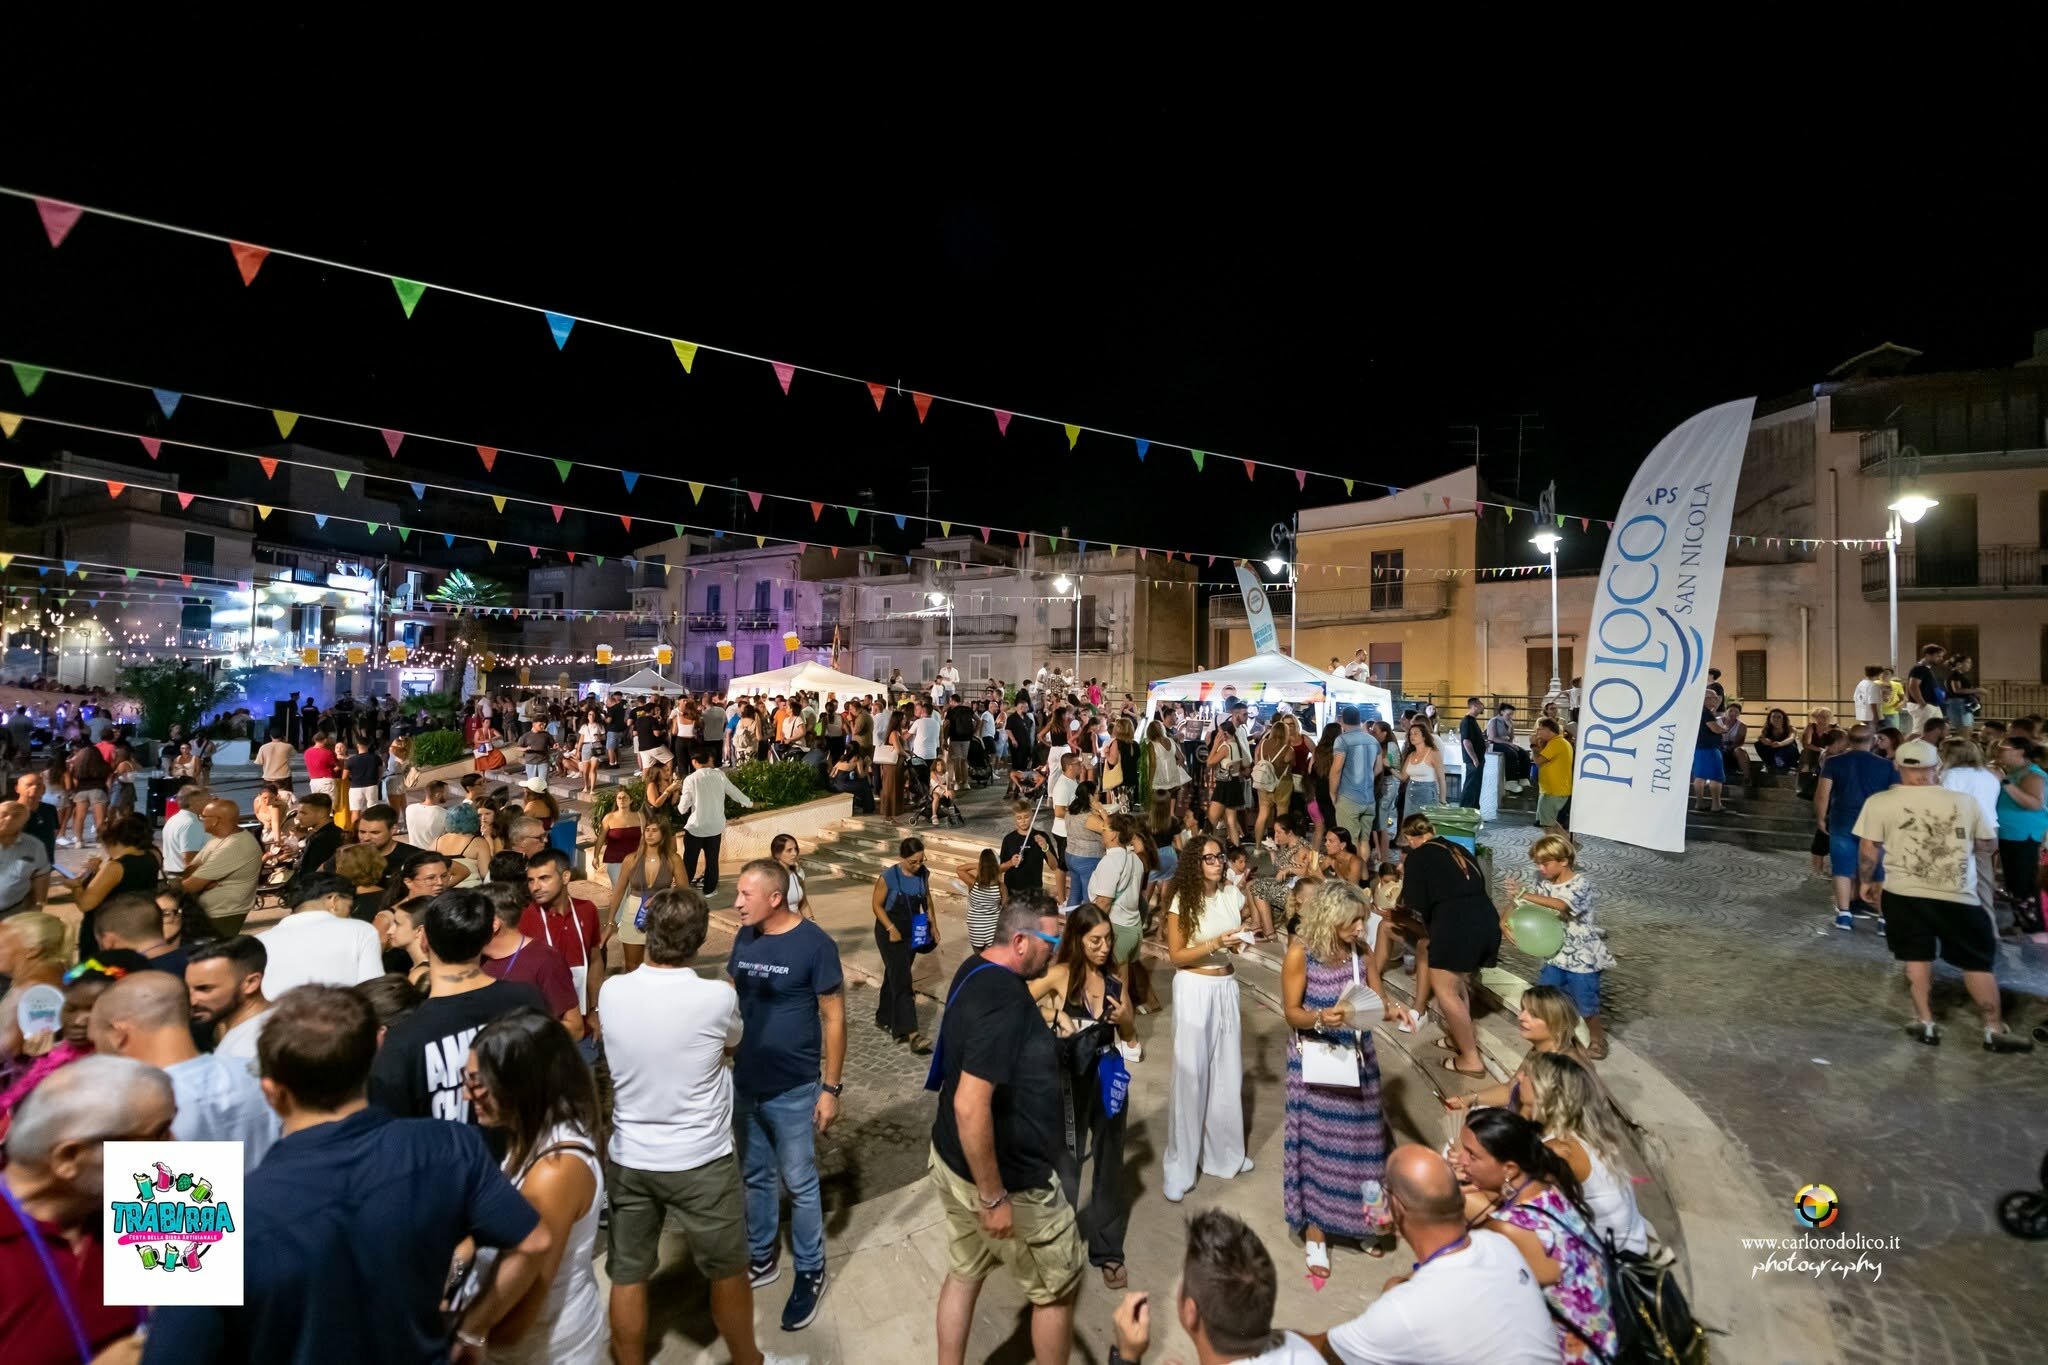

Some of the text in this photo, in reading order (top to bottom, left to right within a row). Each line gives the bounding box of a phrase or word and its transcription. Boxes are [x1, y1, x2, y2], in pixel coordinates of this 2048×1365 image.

[1650, 482, 1713, 793] TRABIA SAN NICOLA
